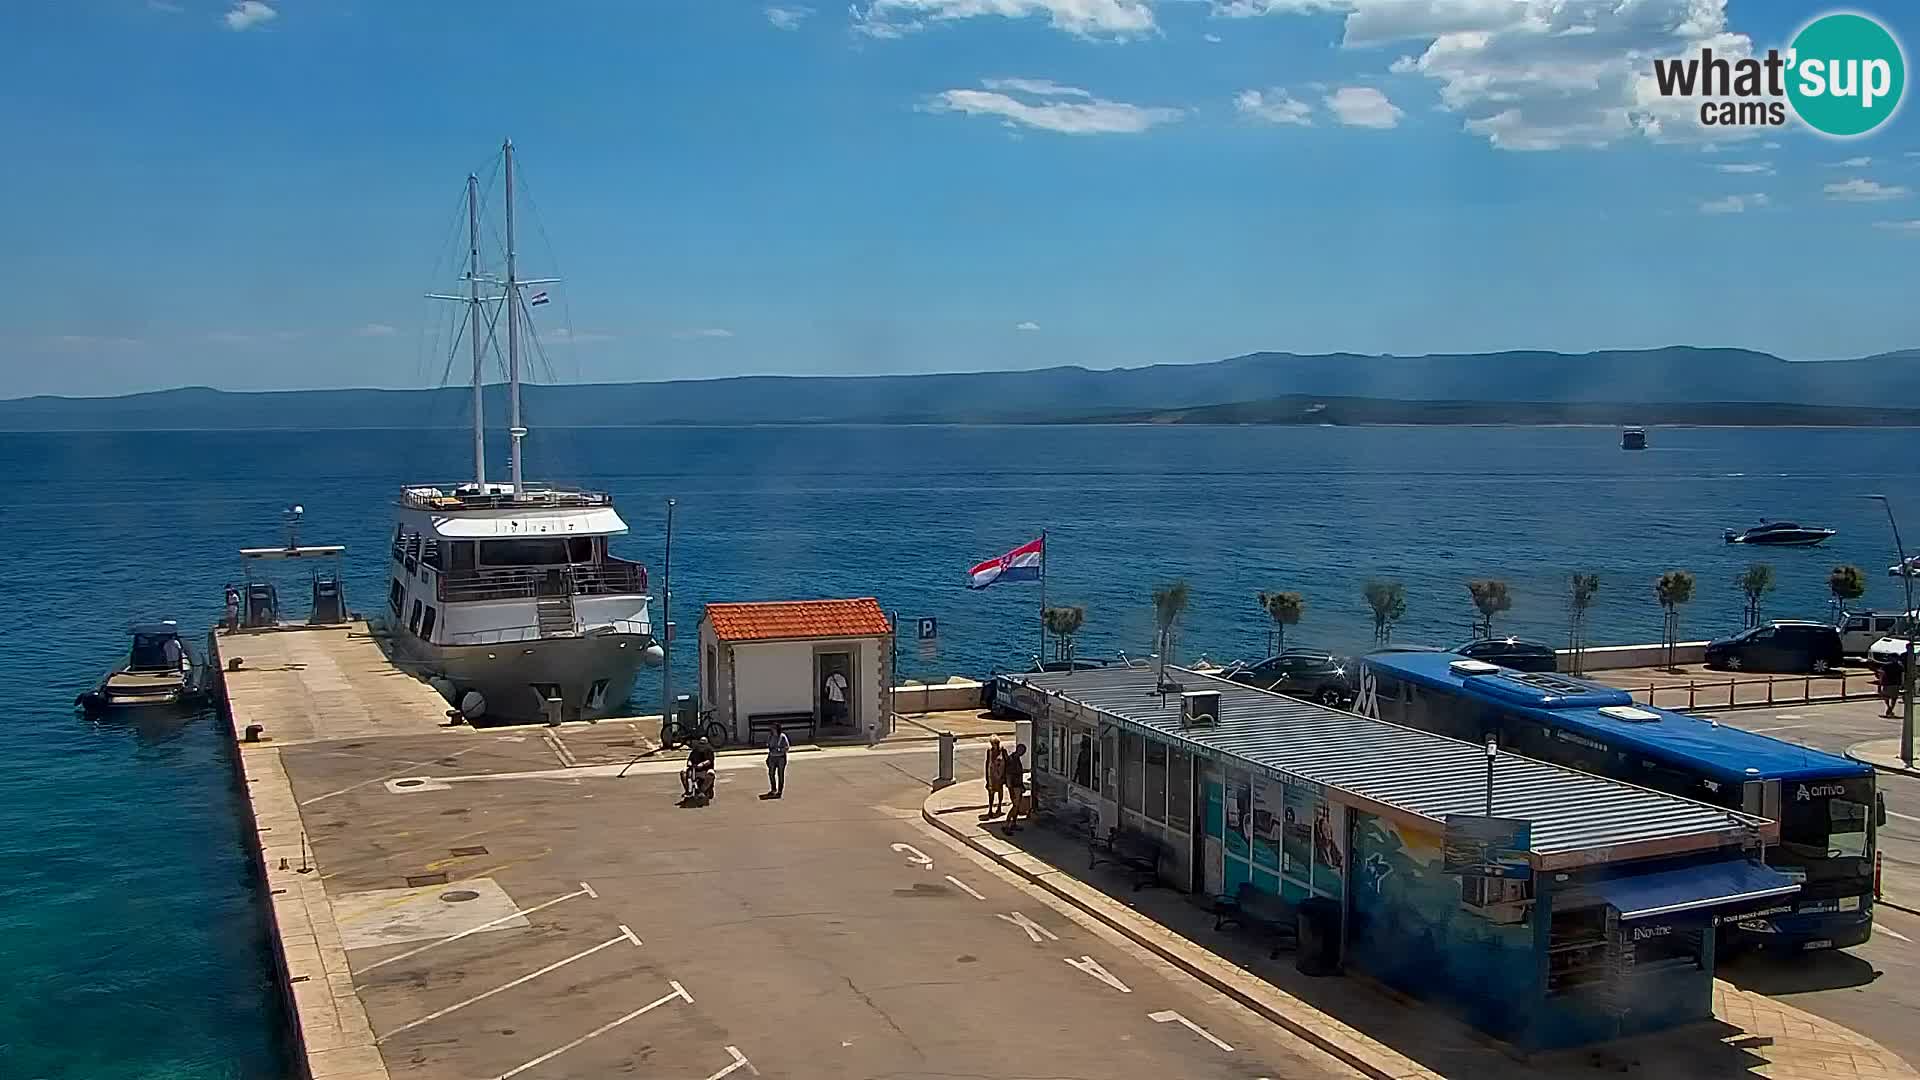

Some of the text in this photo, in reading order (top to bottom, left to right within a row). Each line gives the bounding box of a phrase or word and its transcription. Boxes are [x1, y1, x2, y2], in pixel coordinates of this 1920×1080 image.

[922, 620, 933, 637] P
[1268, 768, 1320, 794] TICKET OFFICE
[1811, 784, 1846, 797] arriva
